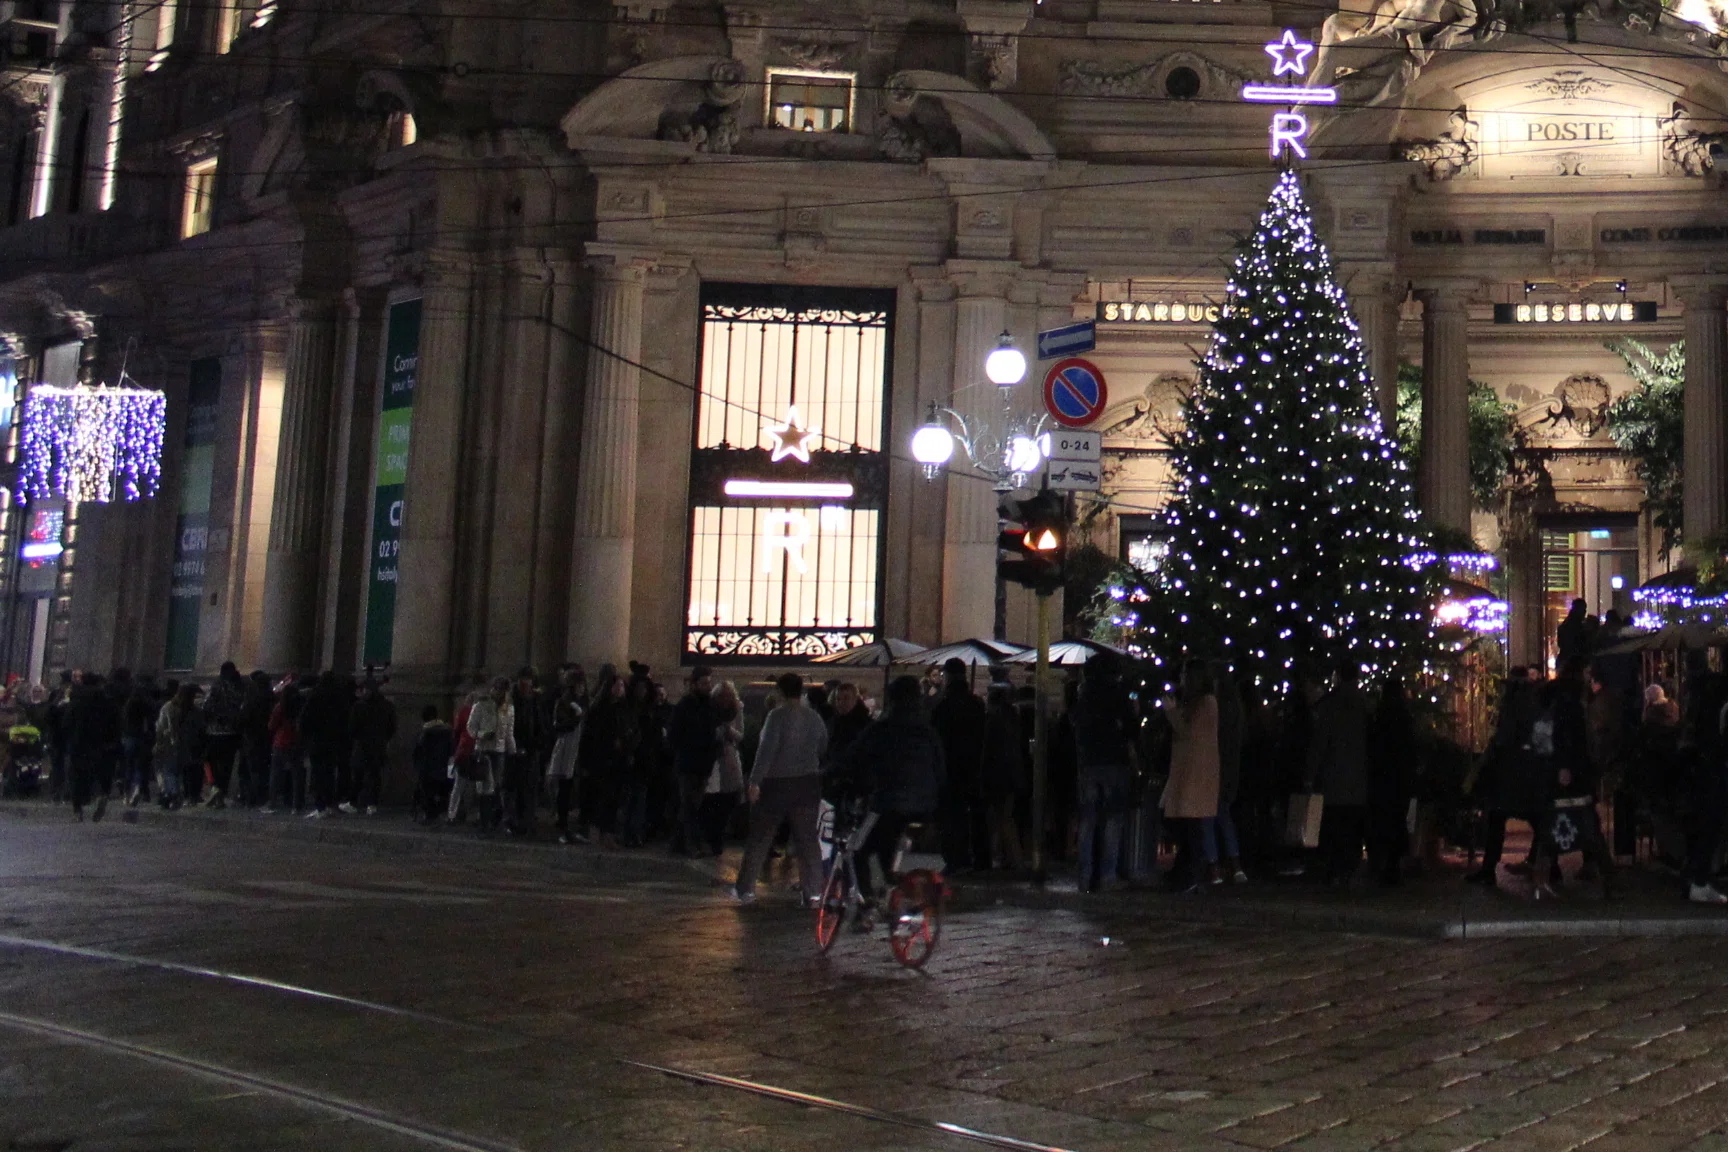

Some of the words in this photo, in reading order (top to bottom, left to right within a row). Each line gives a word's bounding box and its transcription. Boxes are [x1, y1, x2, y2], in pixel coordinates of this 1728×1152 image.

[1527, 122, 1615, 141] POSTE
[1104, 302, 1251, 322] STARBUC
[1516, 303, 1635, 322] RESERVE
[1061, 440, 1089, 451] 0-24
[379, 541, 390, 557] 02
